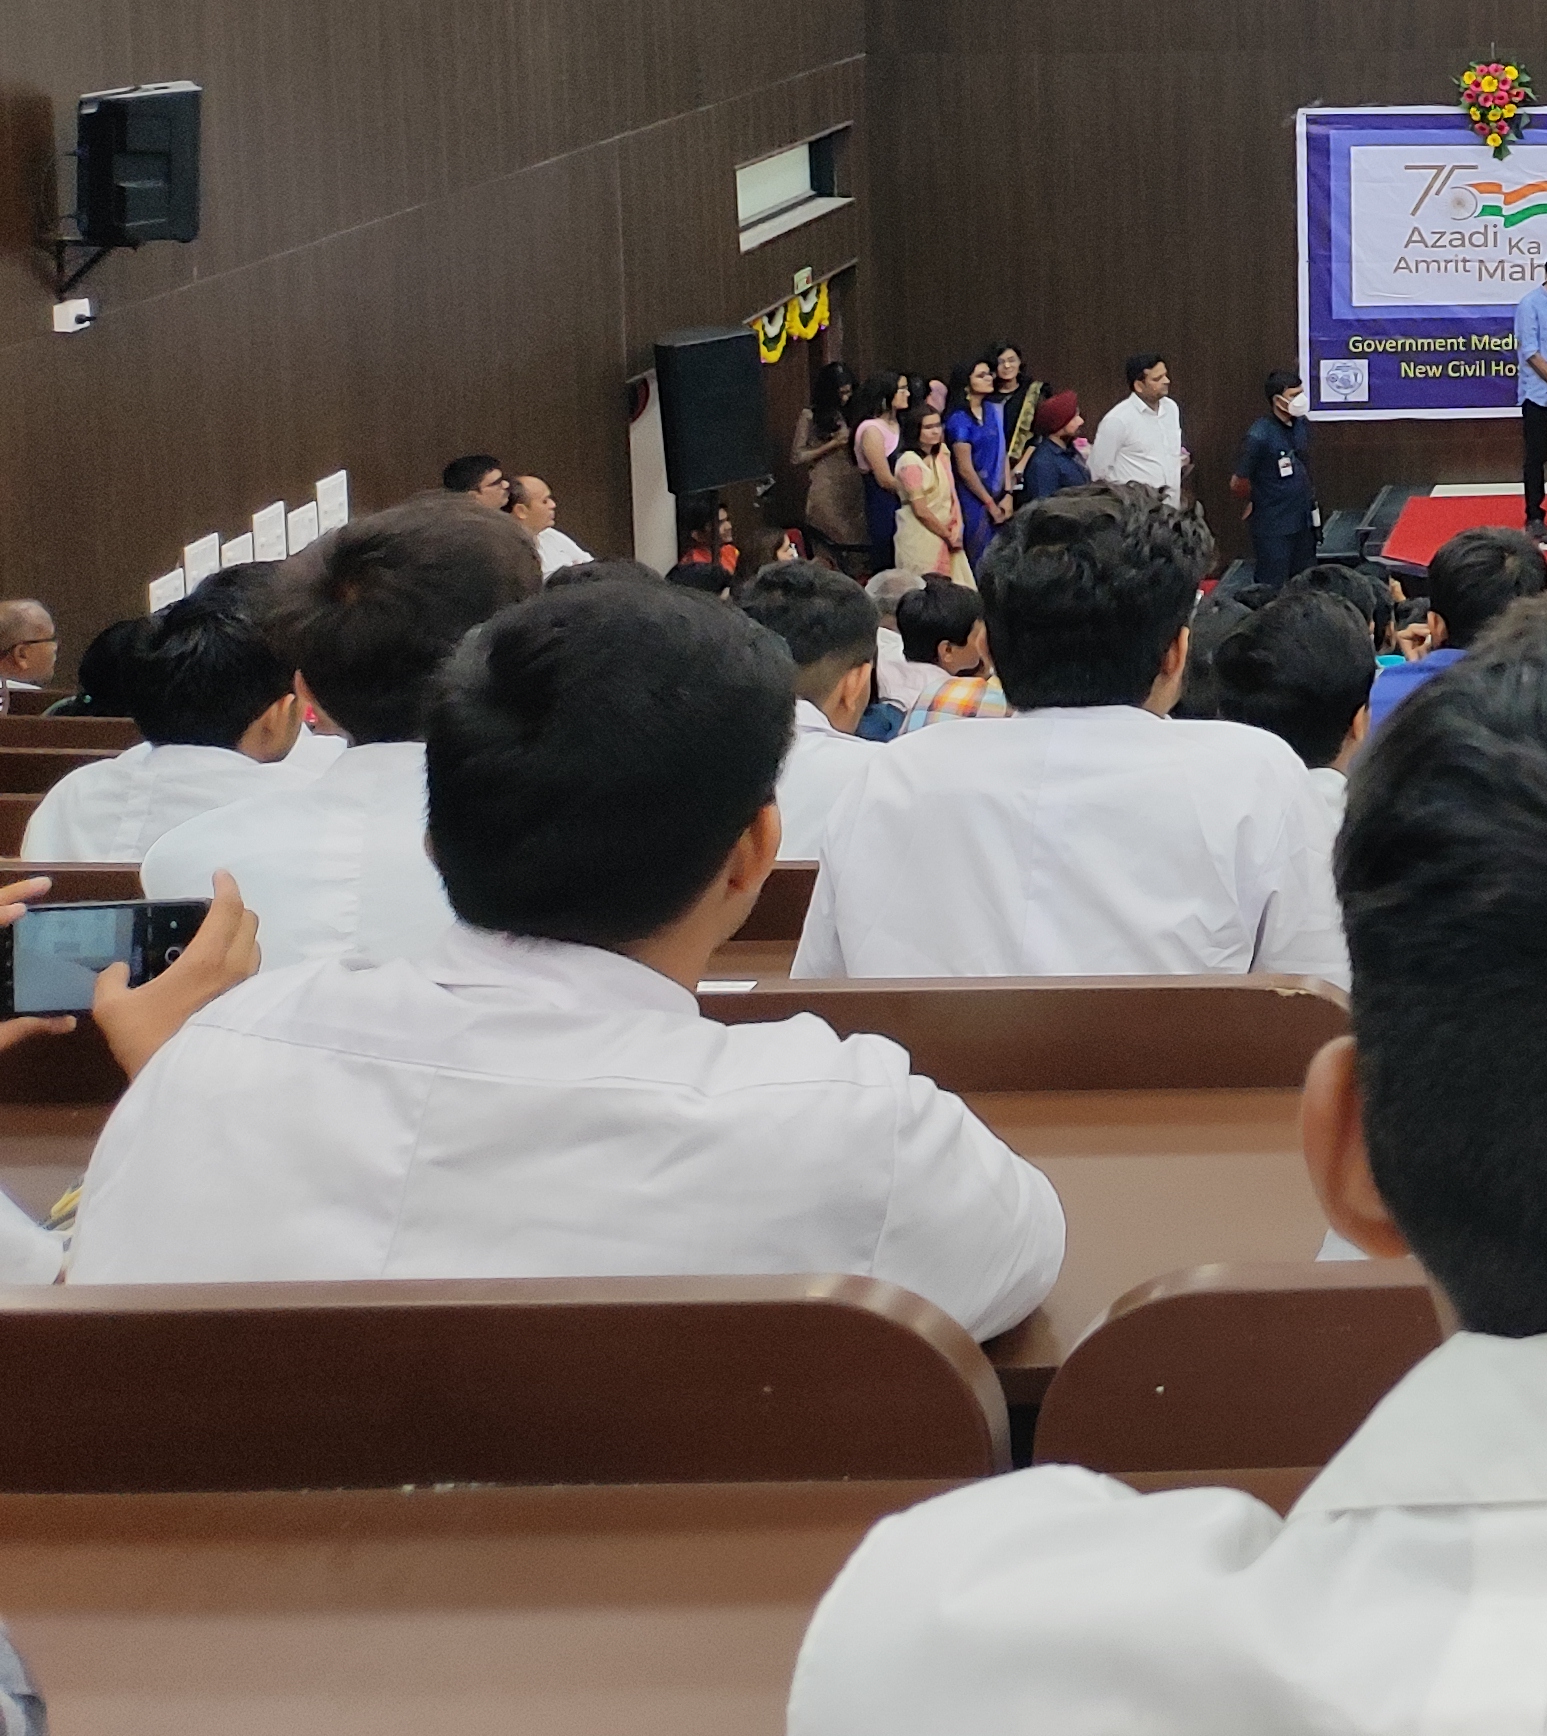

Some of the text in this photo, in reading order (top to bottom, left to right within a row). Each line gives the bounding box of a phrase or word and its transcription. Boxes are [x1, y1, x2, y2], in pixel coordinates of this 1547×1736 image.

[1404, 224, 1541, 255] Azadi Ka
[1393, 254, 1471, 274] Amrit
[1348, 334, 1519, 353] Government Medi
[1400, 361, 1443, 378] New
[1448, 359, 1485, 377] Civil
